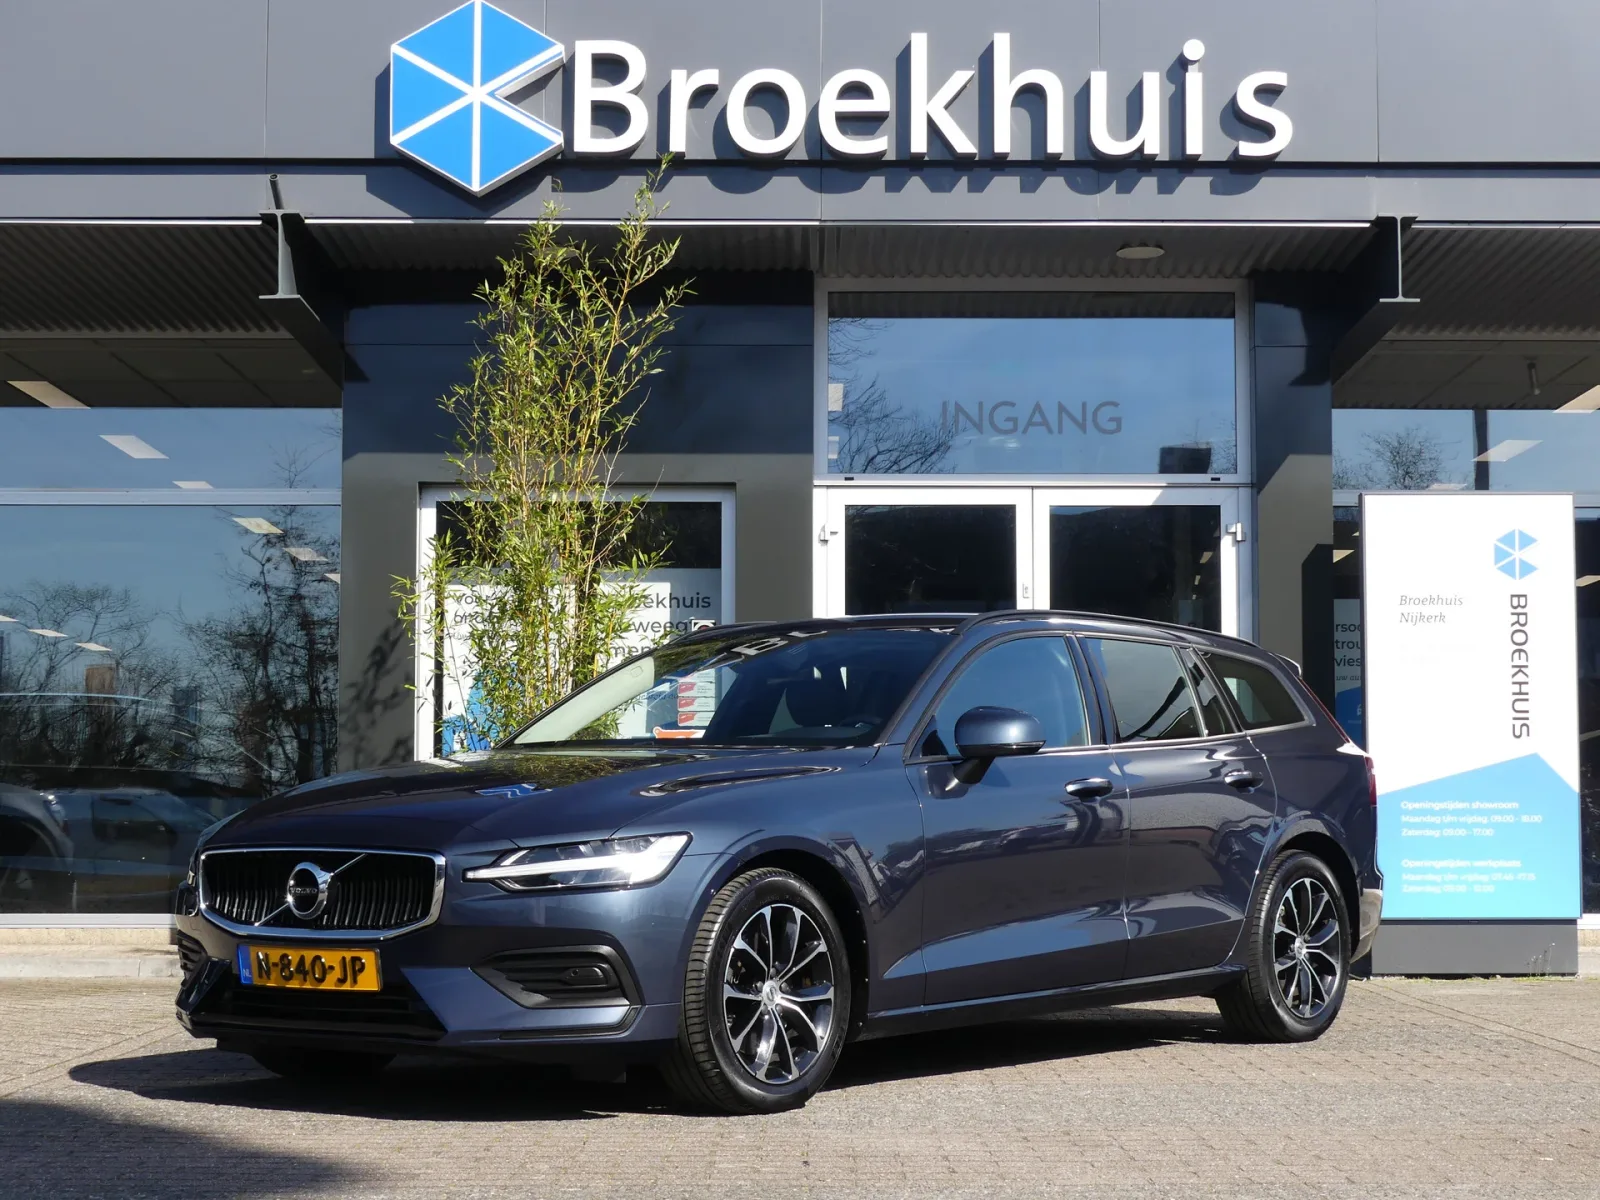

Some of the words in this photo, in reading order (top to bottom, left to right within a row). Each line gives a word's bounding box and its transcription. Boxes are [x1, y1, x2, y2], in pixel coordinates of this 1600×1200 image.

[574, 33, 1293, 157] Broekhuis
[942, 401, 1123, 435] INGANG
[641, 592, 711, 609] ekhuis
[1399, 595, 1463, 606] Broekhuis
[1399, 612, 1446, 626] Nijkerk
[1510, 594, 1530, 739] BROEKHUIS
[1400, 801, 1470, 810] Openingstijden
[1471, 801, 1519, 809] showroom
[1401, 815, 1441, 823] Maandag
[256, 951, 366, 985] N-840-JP
